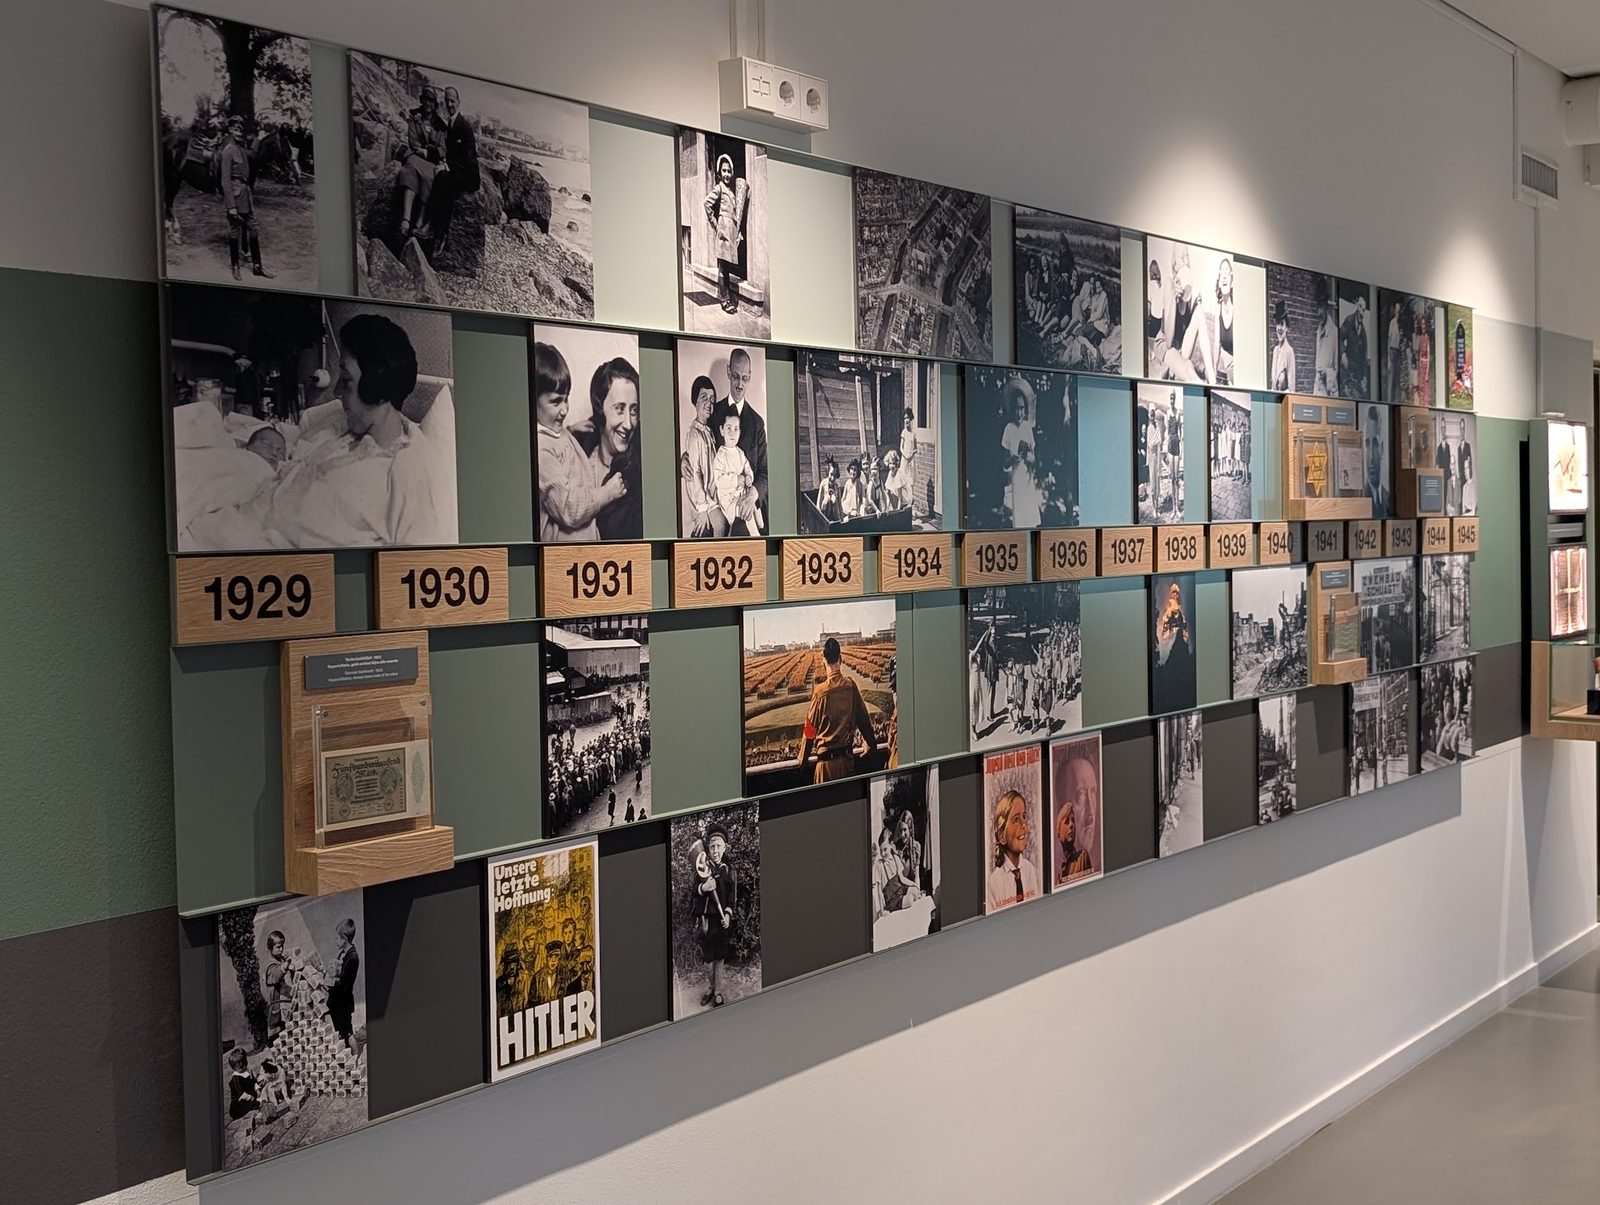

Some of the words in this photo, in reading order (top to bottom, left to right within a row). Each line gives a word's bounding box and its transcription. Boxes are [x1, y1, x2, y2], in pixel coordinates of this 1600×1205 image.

[1217, 533, 1247, 558] 1939
[1267, 531, 1294, 554] 1940
[1314, 530, 1338, 551] 1941
[1353, 528, 1377, 549] 1942
[1391, 527, 1412, 548] 1943
[1426, 526, 1446, 546] 1944
[1457, 525, 1476, 544] 1945
[975, 543, 1019, 573] 1935
[1049, 540, 1088, 568] 1936
[1111, 538, 1145, 564] 1937
[1165, 535, 1197, 561] 1938
[690, 556, 754, 592] 1932
[797, 551, 852, 585] 1933
[893, 547, 942, 578] 1934
[401, 565, 490, 610] 1930
[566, 560, 633, 599] 1931
[204, 573, 312, 621] 1929
[494, 859, 537, 880] Unsere
[496, 873, 540, 896] letzte
[494, 886, 555, 913] Hoffnung:
[499, 990, 596, 1067] HITLER
